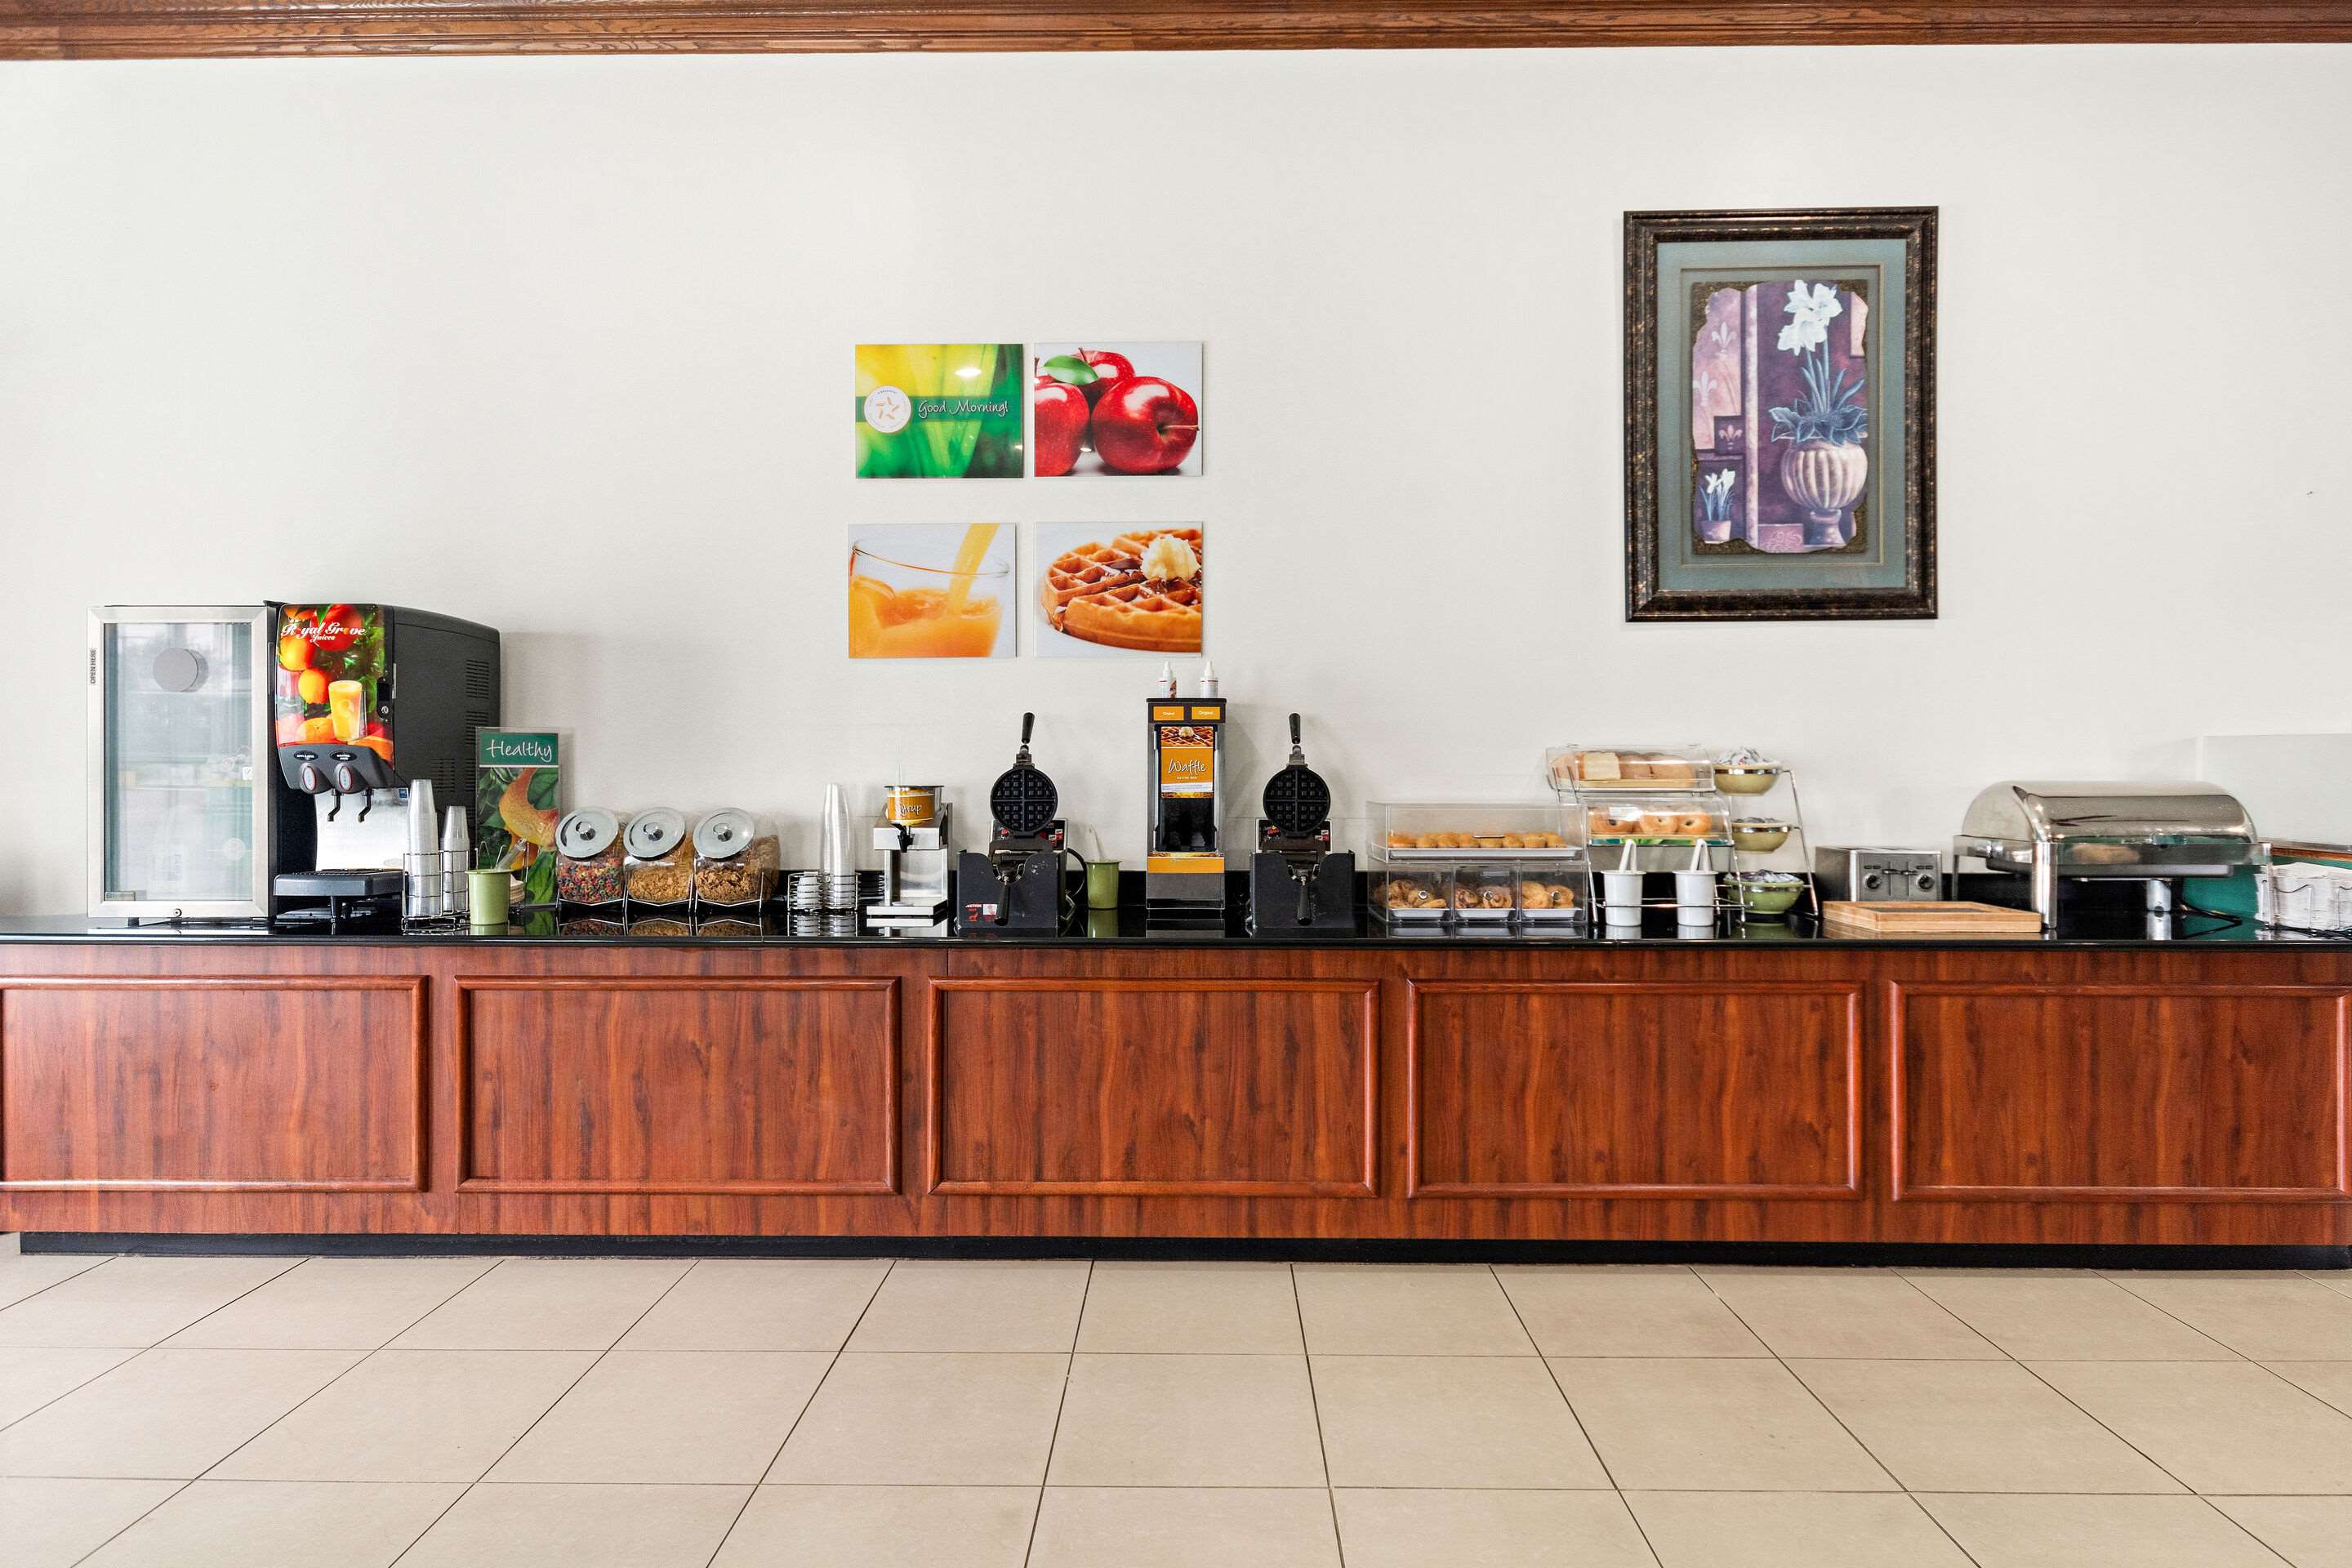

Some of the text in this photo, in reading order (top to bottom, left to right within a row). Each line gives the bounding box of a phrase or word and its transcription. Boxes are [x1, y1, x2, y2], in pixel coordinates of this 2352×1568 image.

[918, 399, 1009, 419] Good Morning!
[485, 738, 552, 763] Healthy
[1168, 758, 1207, 776] Waffle
